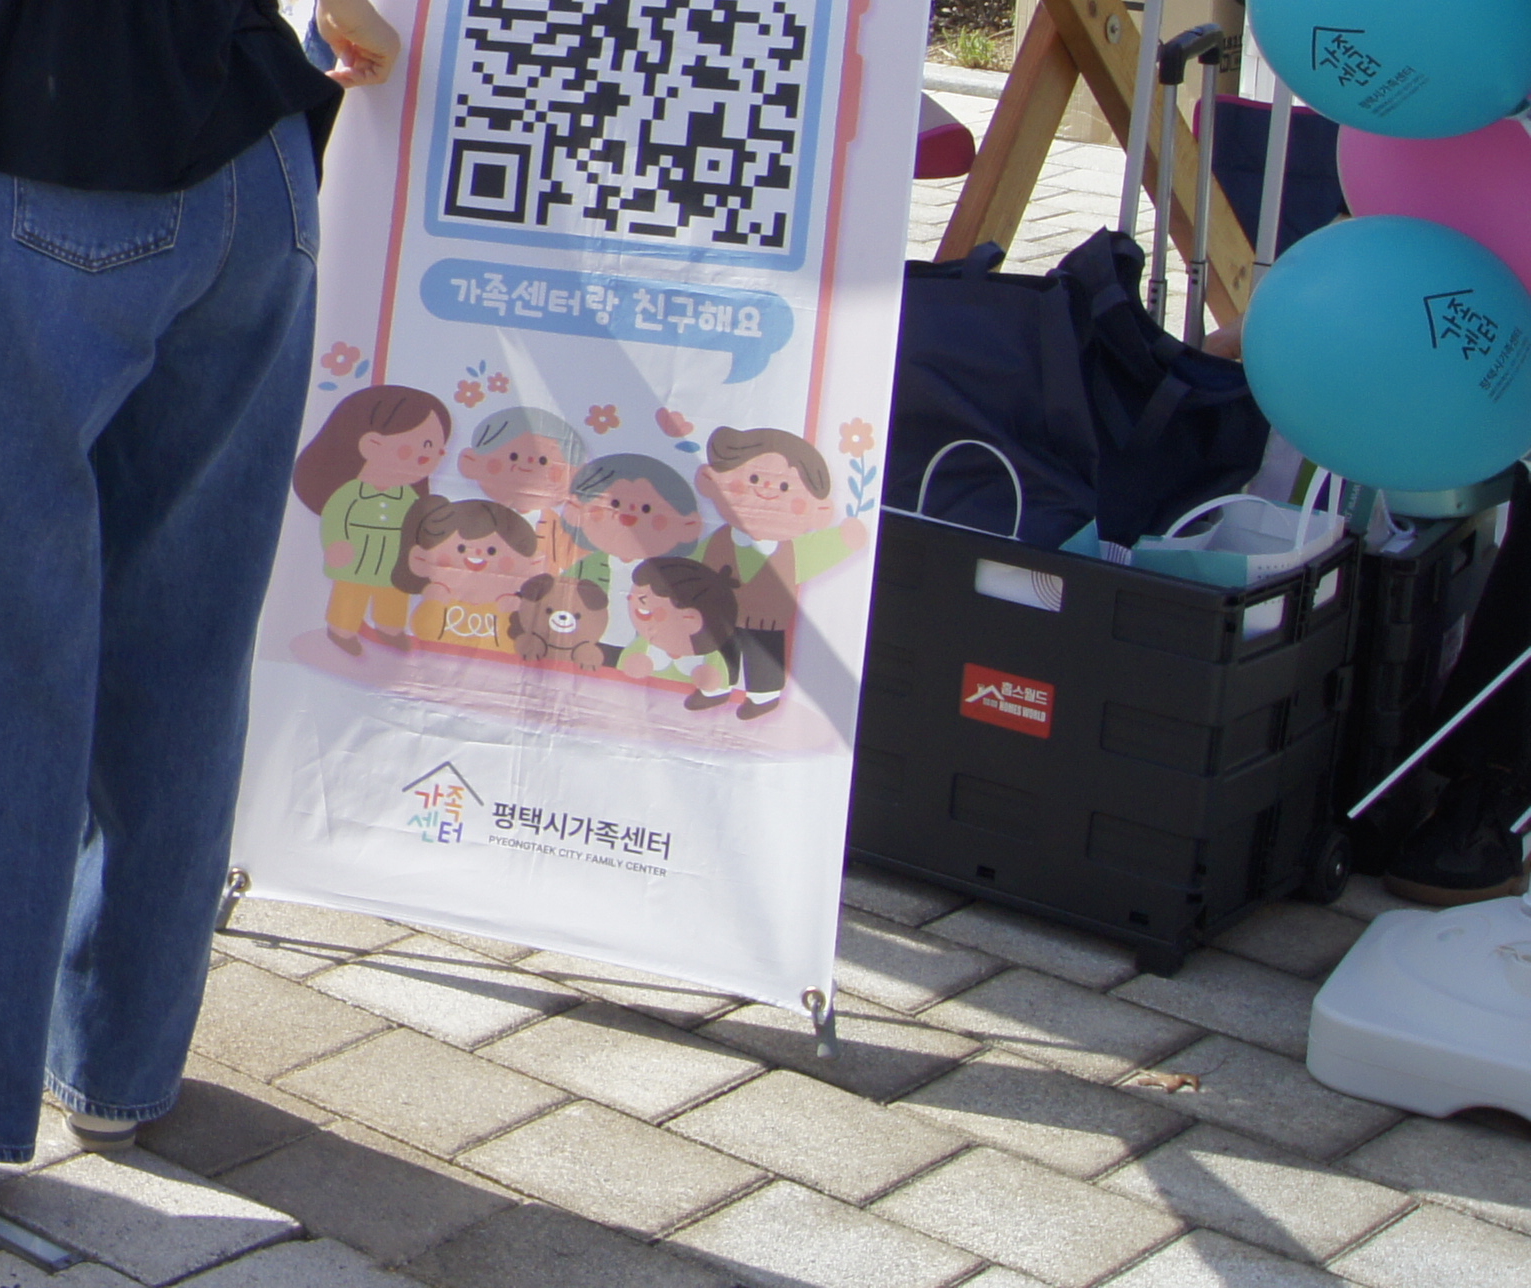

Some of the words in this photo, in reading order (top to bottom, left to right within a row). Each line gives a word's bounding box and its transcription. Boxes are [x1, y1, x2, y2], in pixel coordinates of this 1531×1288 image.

[1320, 34, 1364, 69] 가족
[1338, 54, 1381, 87] 센터
[450, 272, 619, 326] 가족센터랑
[633, 288, 763, 338] 친구해요
[1441, 297, 1482, 339] 가족
[1462, 315, 1498, 360] 센터
[414, 783, 465, 823] 가족
[406, 810, 464, 844] 센터
[492, 801, 672, 860] 평택시가족센터
[488, 835, 557, 857] PYEONGTAEK
[558, 847, 583, 861] CITY
[585, 853, 624, 868] FAMILY
[625, 861, 667, 877] CENTER
